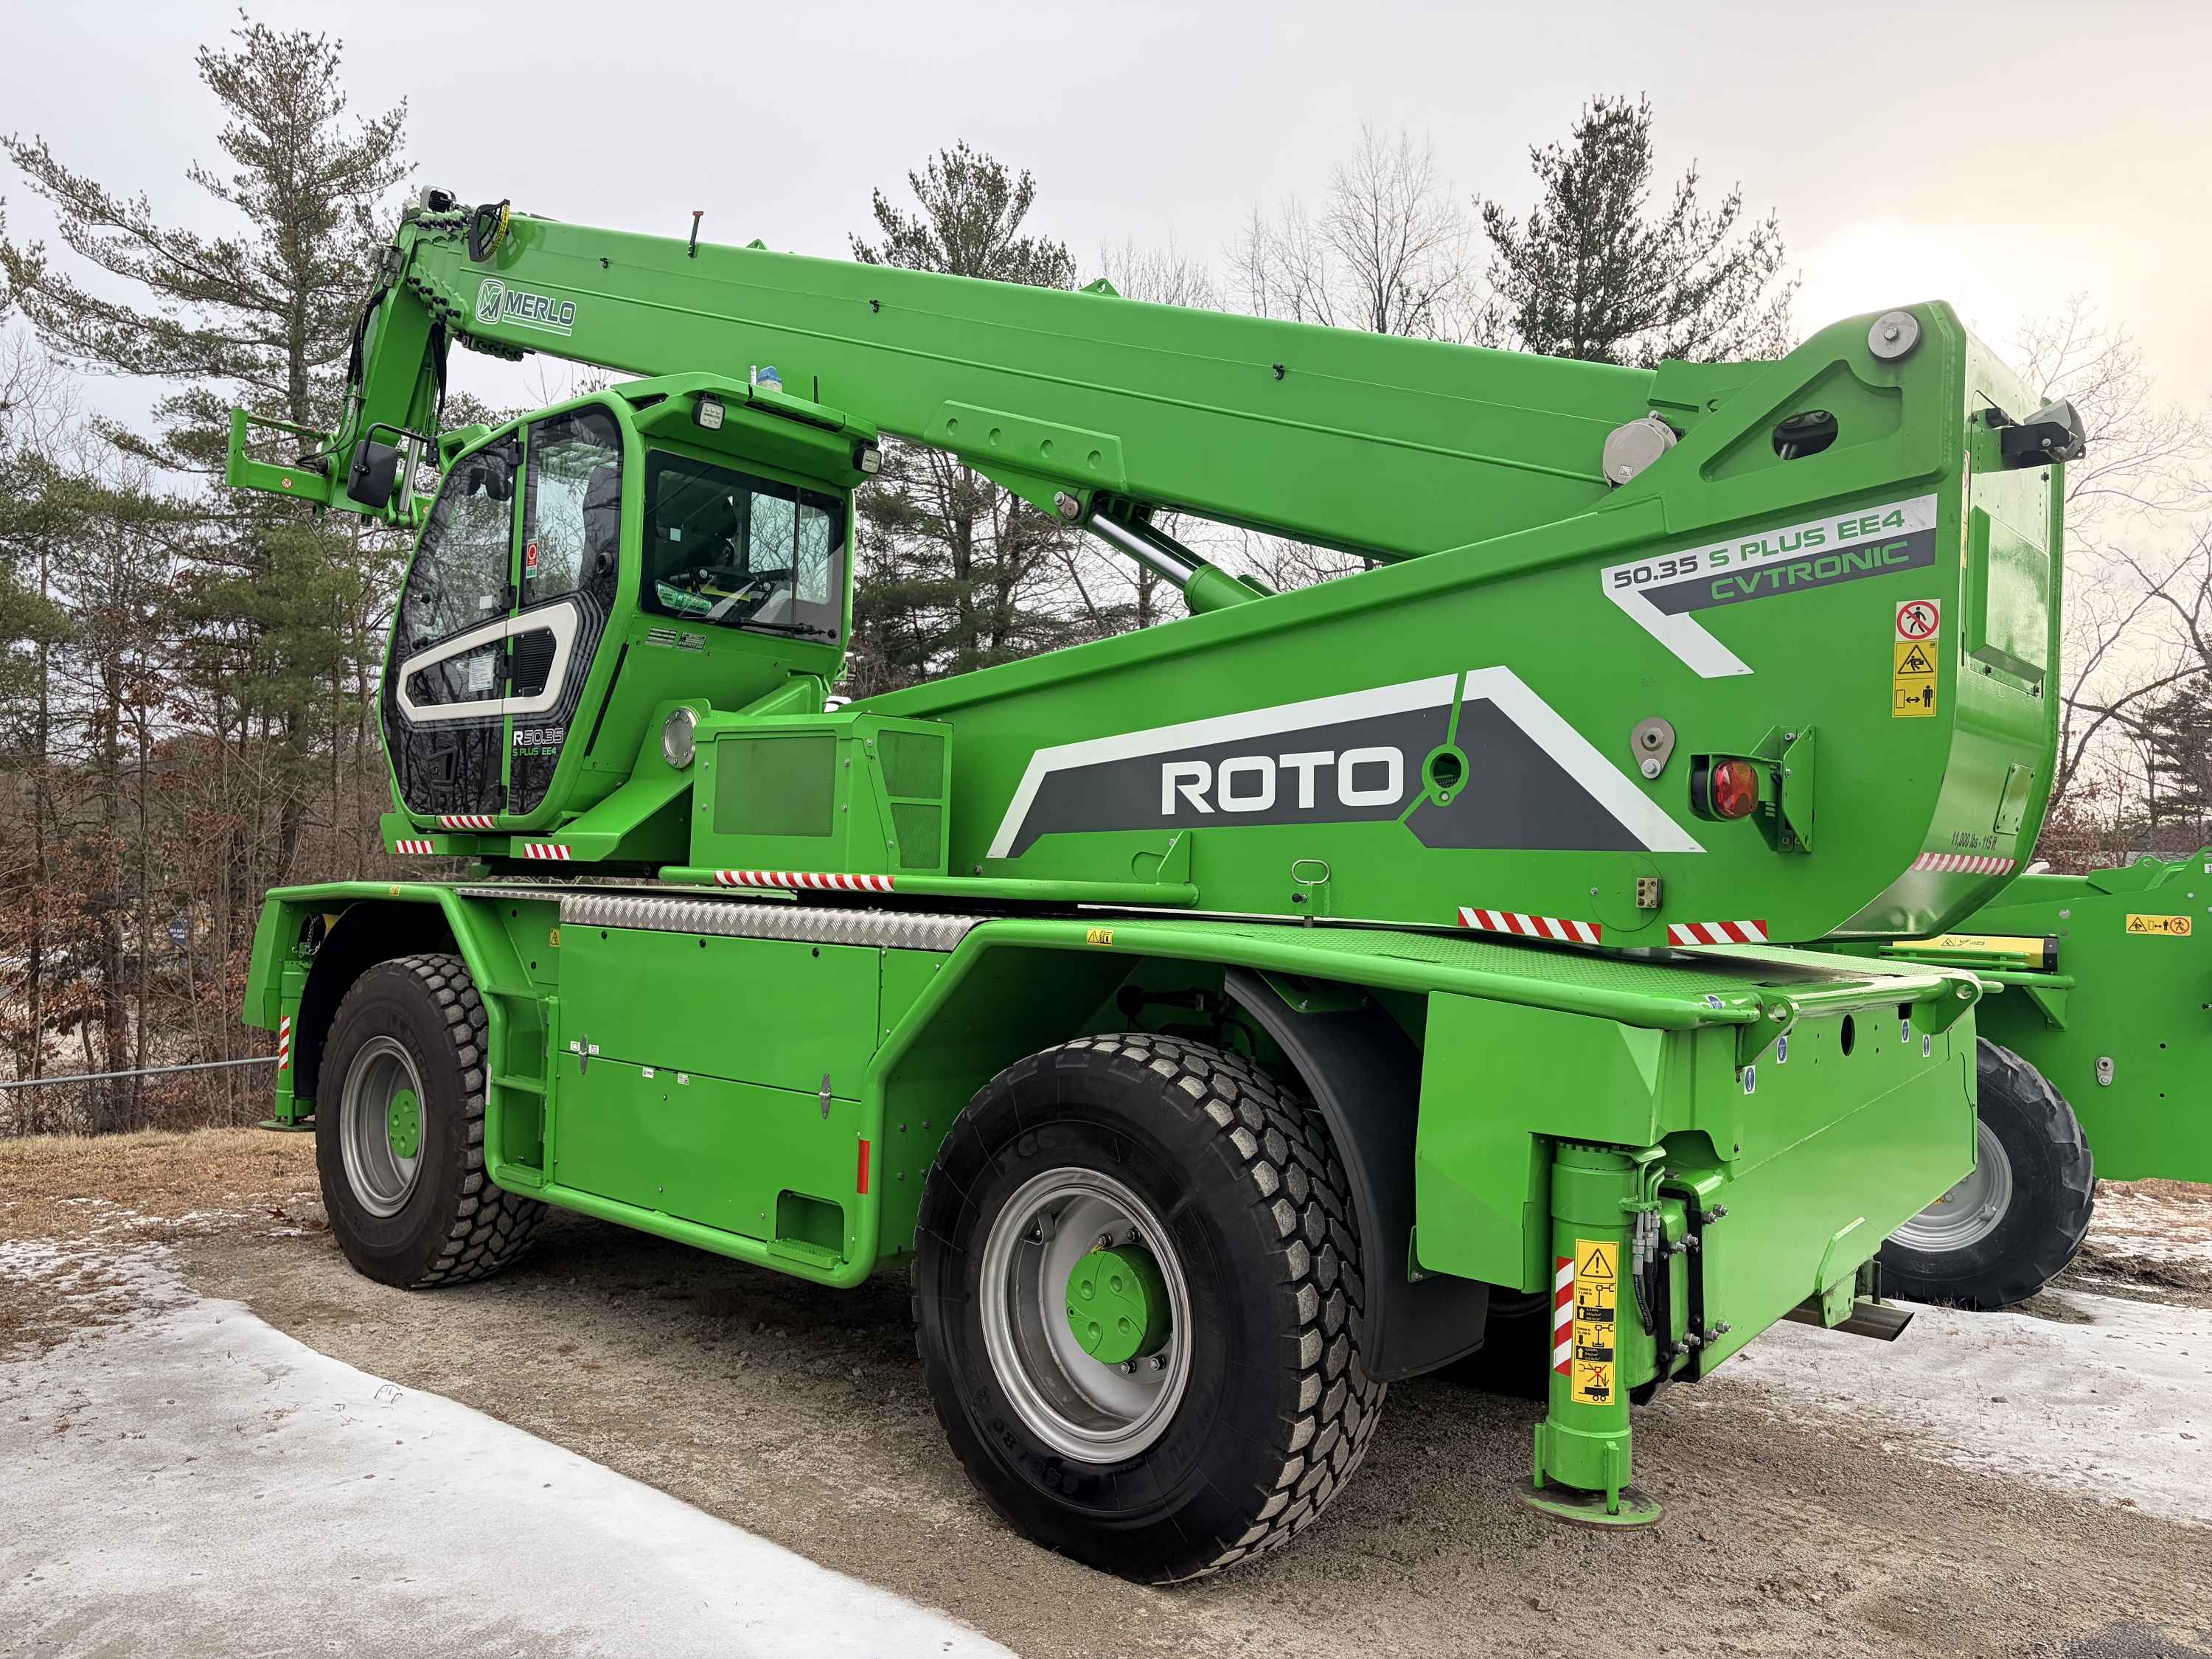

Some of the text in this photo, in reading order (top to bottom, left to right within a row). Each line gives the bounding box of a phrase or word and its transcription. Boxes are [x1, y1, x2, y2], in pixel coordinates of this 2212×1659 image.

[504, 290, 577, 326] MERLO
[1614, 509, 1905, 589] 50.35 S PLUS EE4
[1711, 540, 1910, 600] CVTRONIC
[512, 746, 557, 757] S PLUS EE4
[1161, 746, 1404, 815] ROTO
[1951, 832, 1970, 849] 11,000
